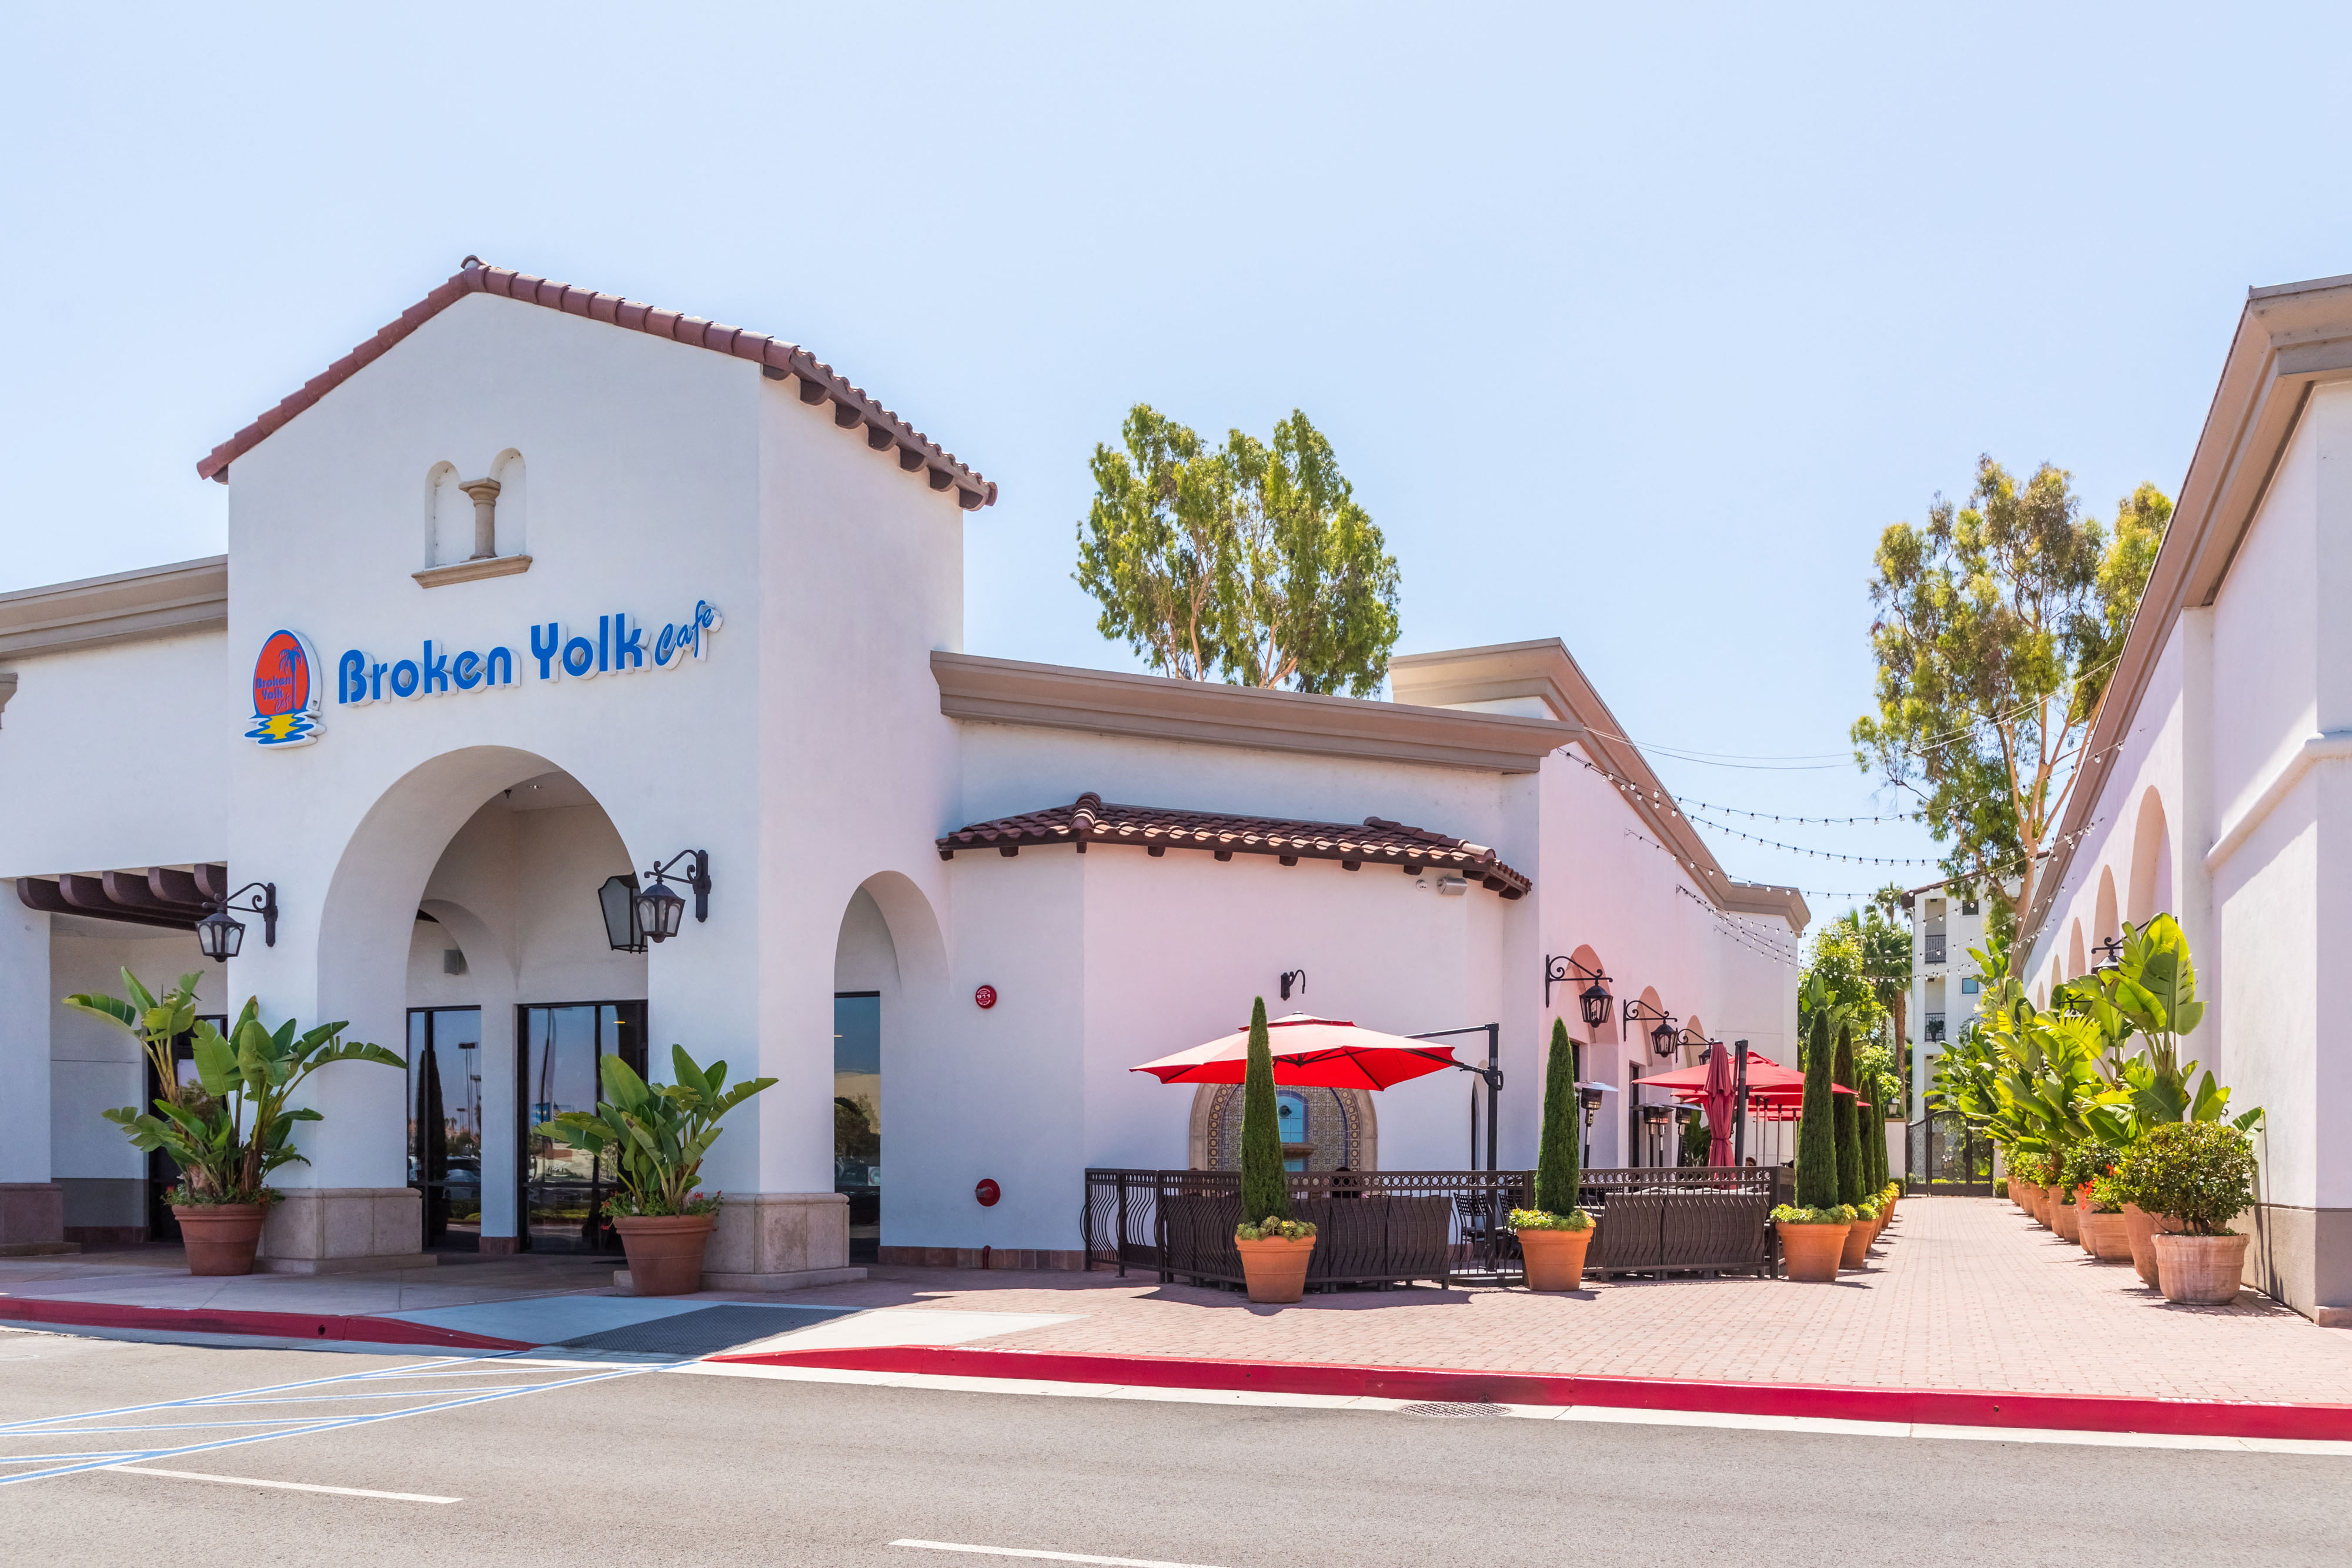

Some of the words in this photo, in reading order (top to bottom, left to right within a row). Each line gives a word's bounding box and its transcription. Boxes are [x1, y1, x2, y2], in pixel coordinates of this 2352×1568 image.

[339, 640, 512, 704] Broken
[530, 613, 643, 680] Yolk
[654, 600, 714, 666] Cafe
[256, 676, 292, 688] Broken
[263, 687, 283, 701] Yolk
[275, 693, 291, 713] Cafe
